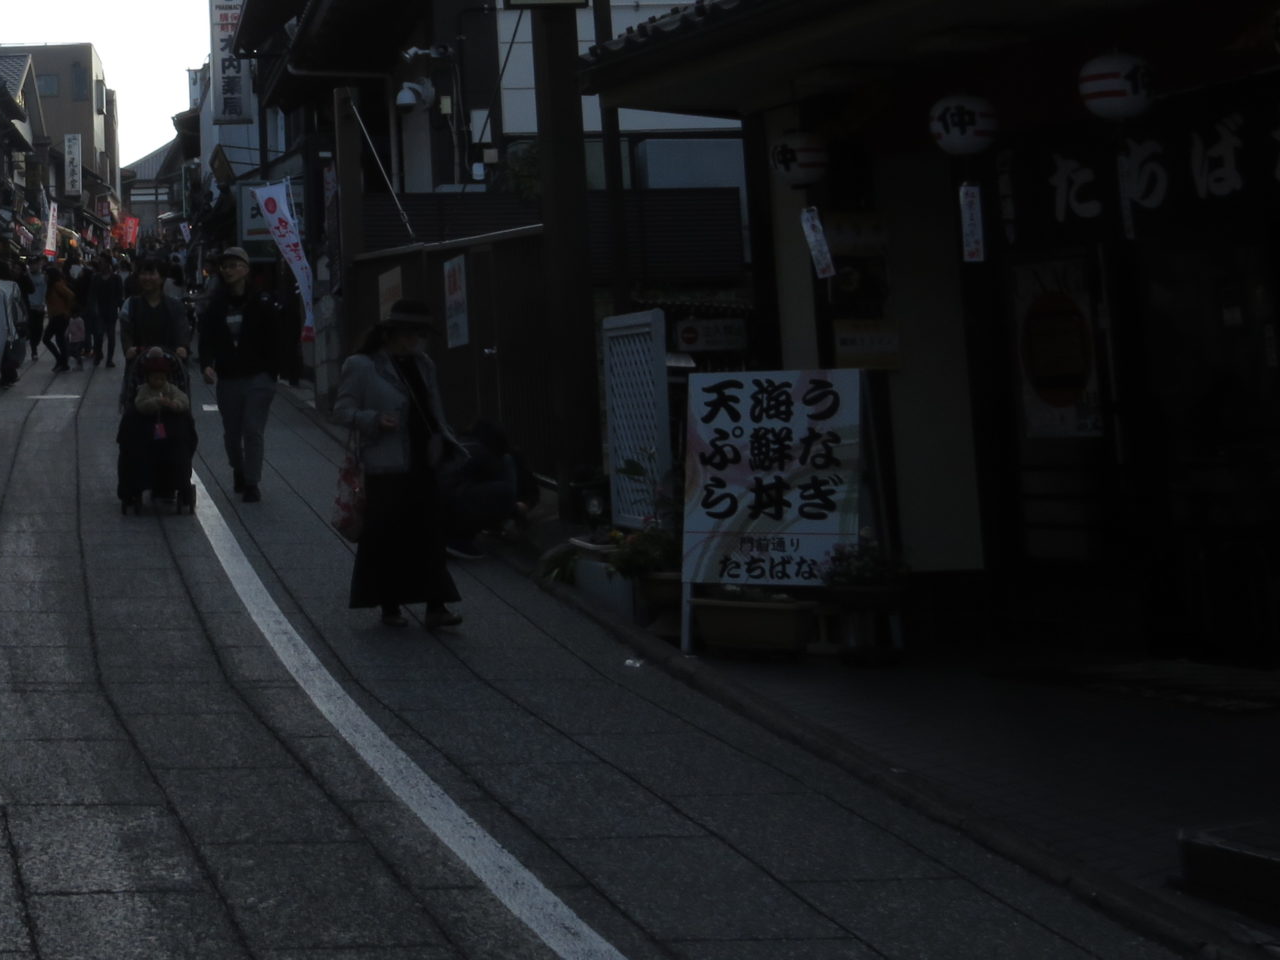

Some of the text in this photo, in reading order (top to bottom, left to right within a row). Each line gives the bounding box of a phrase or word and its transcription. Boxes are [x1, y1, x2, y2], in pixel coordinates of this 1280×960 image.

[940, 105, 977, 136] 仲
[1048, 113, 1280, 223] たちば
[699, 379, 745, 520] 天ぷら
[749, 378, 795, 521] 海鮮丼
[800, 378, 844, 521] うなぎ
[719, 555, 821, 581] たちばな
[739, 537, 801, 553] 門前通り
